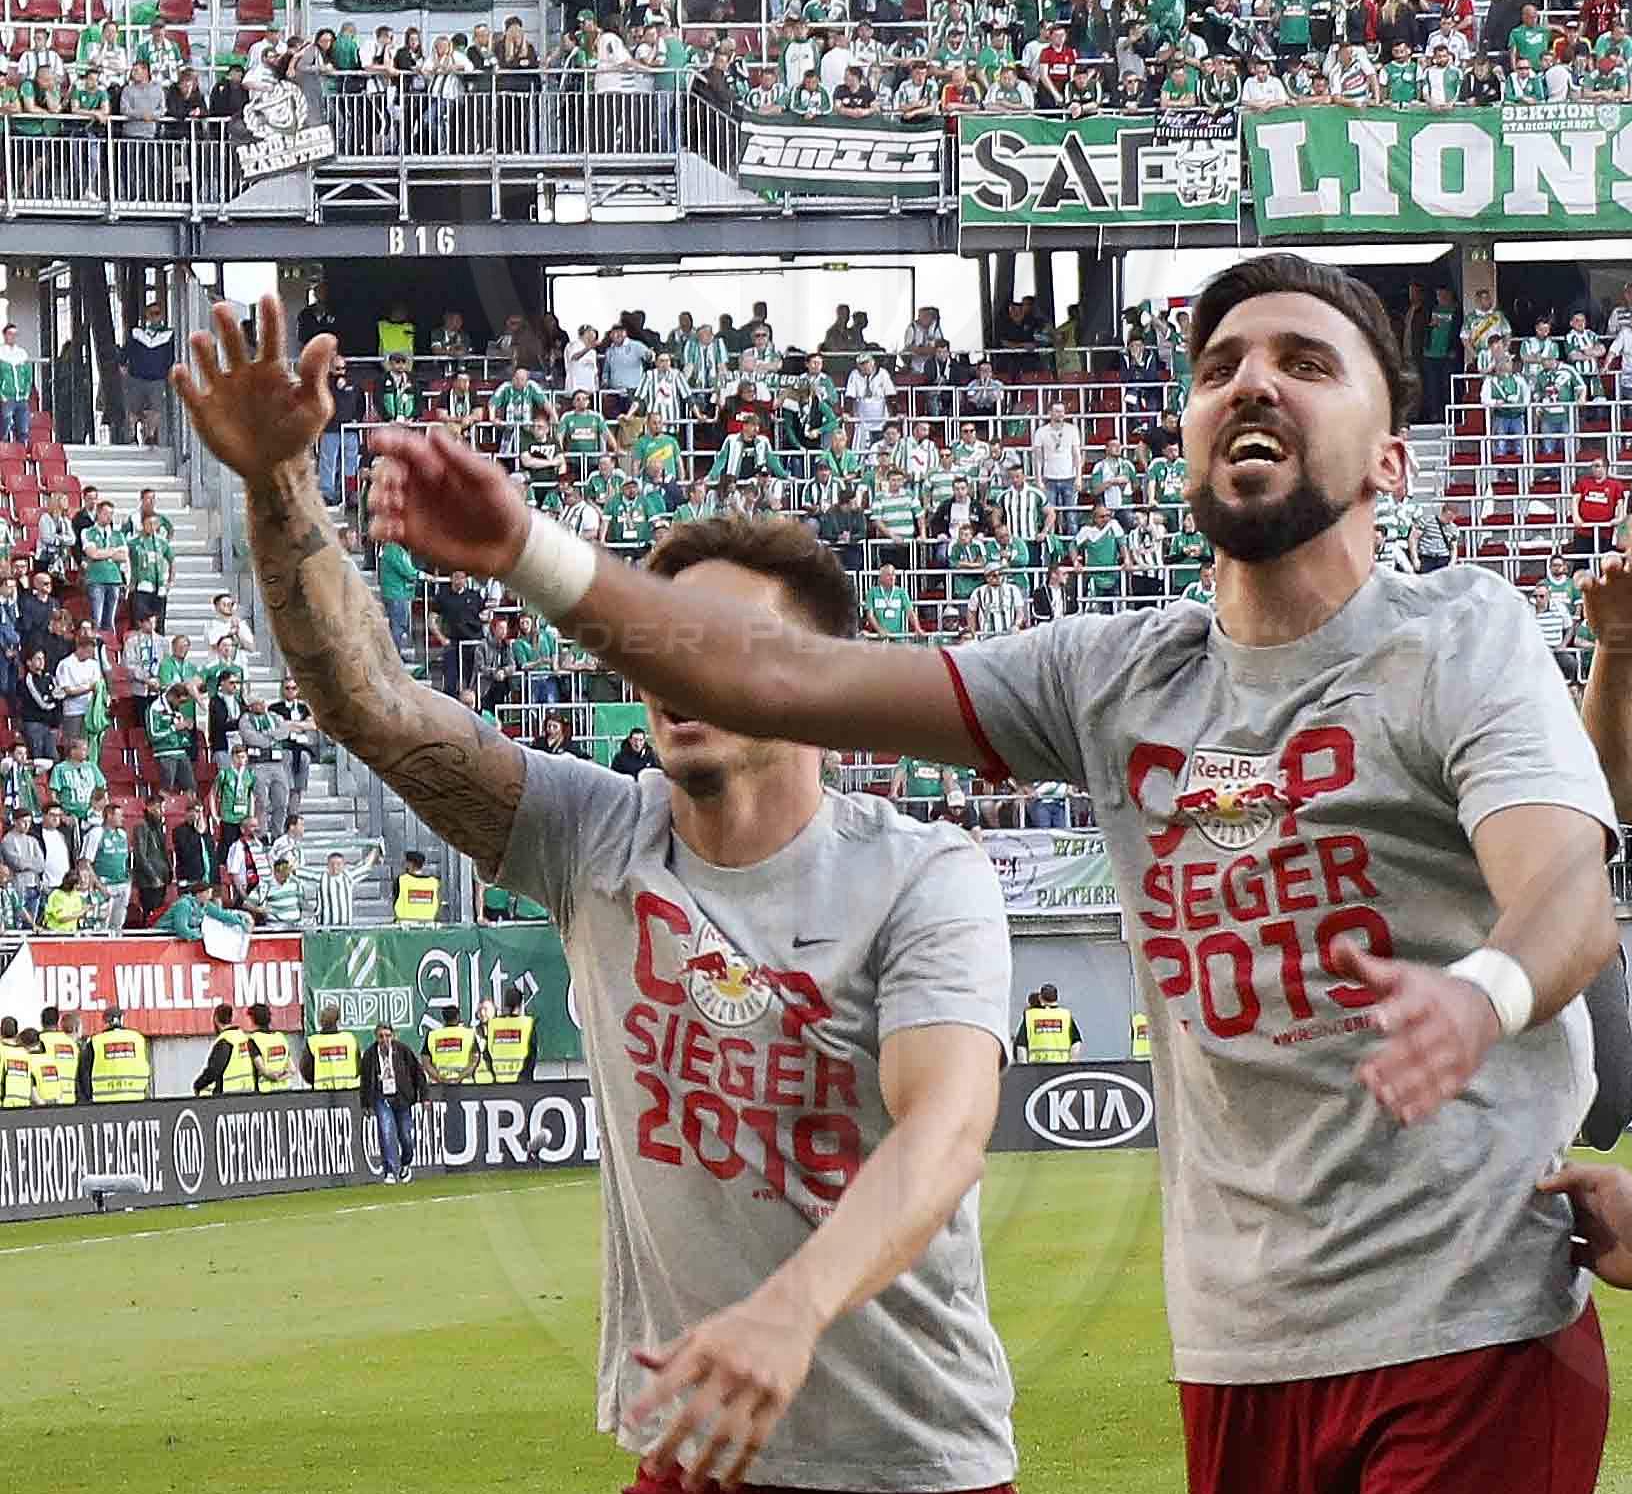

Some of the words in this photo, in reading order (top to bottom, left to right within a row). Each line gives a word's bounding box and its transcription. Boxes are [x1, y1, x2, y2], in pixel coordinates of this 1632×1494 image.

[1128, 724, 1354, 858] CP
[1141, 834, 1376, 930] SEGER
[39, 965, 107, 1012] UBE.
[114, 963, 222, 1009] WILLE.
[234, 962, 304, 1007] MUT
[634, 891, 832, 1037] CP
[625, 1005, 860, 1108] SIEGER
[179, 1128, 201, 1178] KIA
[217, 1111, 286, 1188] OFFICIAL
[289, 1106, 354, 1180] PARTNER
[634, 1072, 861, 1200] 2019
[1048, 1087, 1131, 1129] KIA
[16, 1123, 88, 1206] EUROPA
[92, 1119, 164, 1195] LEAGUE
